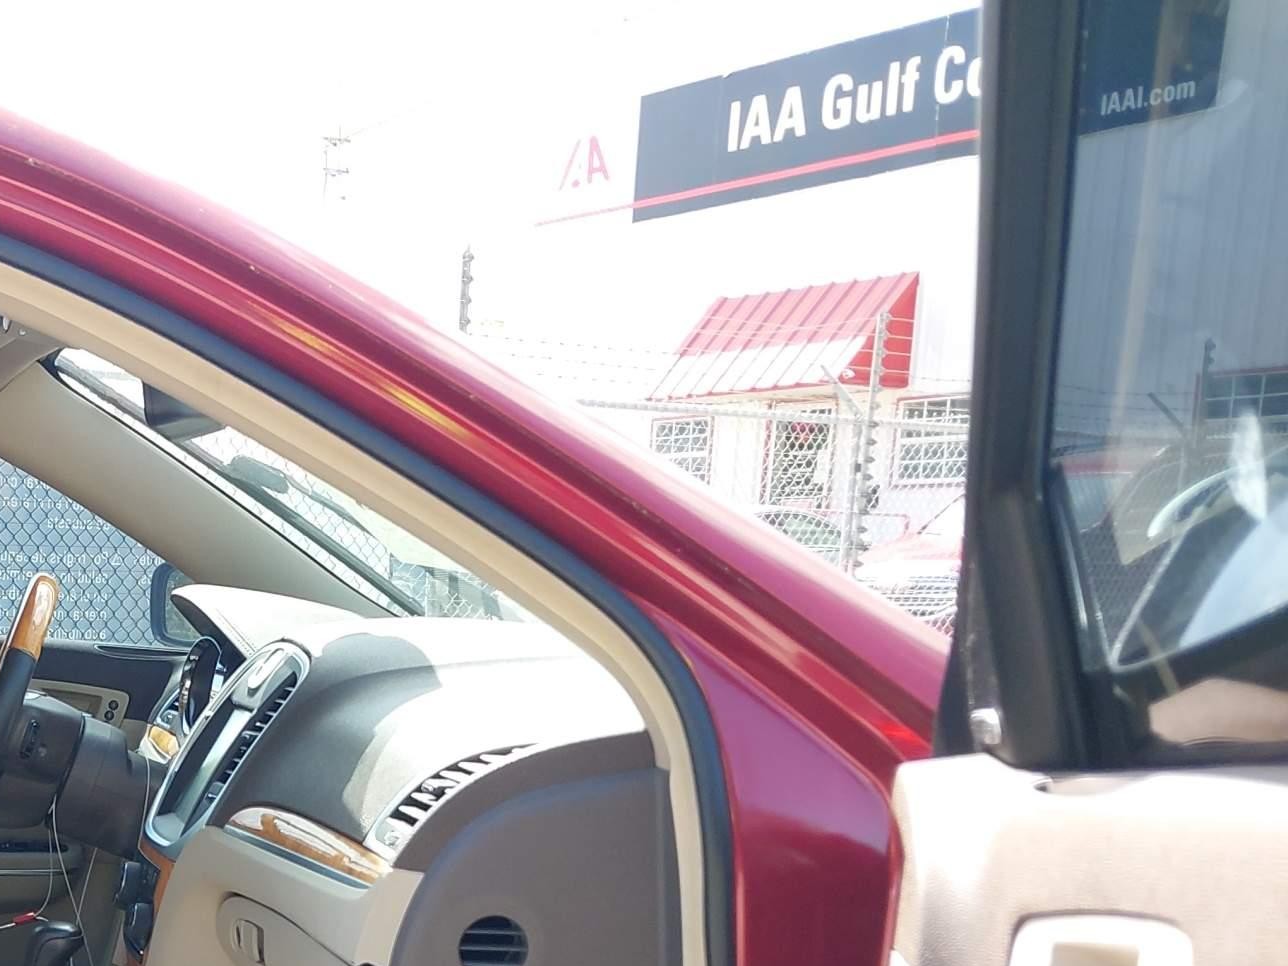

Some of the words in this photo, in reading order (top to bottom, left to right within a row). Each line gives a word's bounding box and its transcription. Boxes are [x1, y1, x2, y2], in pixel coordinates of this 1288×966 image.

[727, 85, 806, 152] IAA
[821, 55, 921, 130] Gulf
[934, 45, 983, 105] Co
